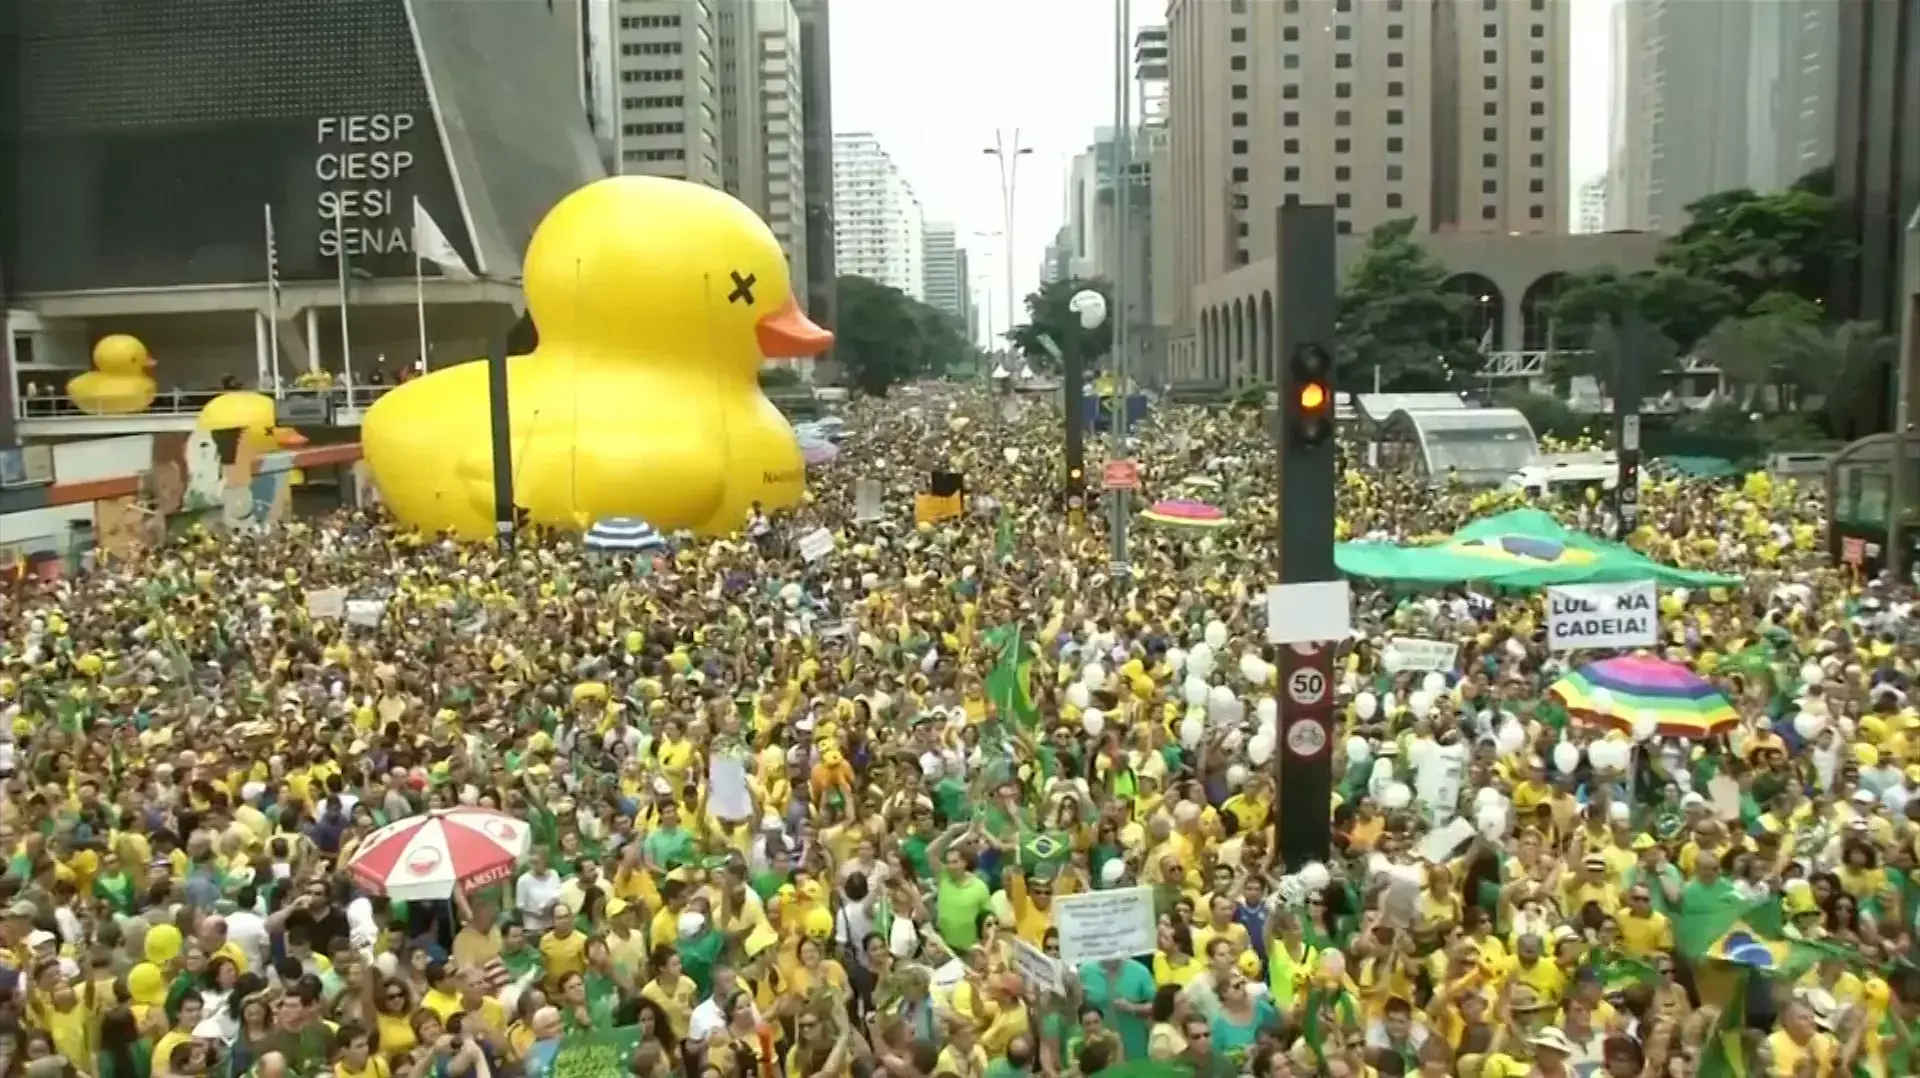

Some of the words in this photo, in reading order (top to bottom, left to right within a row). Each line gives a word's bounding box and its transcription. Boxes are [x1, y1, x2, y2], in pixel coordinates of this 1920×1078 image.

[317, 114, 414, 143] FIESP
[316, 151, 413, 181] CIESP
[317, 188, 392, 219] SESI
[1552, 596, 1606, 615] LUL
[1616, 593, 1649, 610] NA
[1554, 617, 1648, 637] CADEIA!
[1293, 674, 1322, 694] 50
